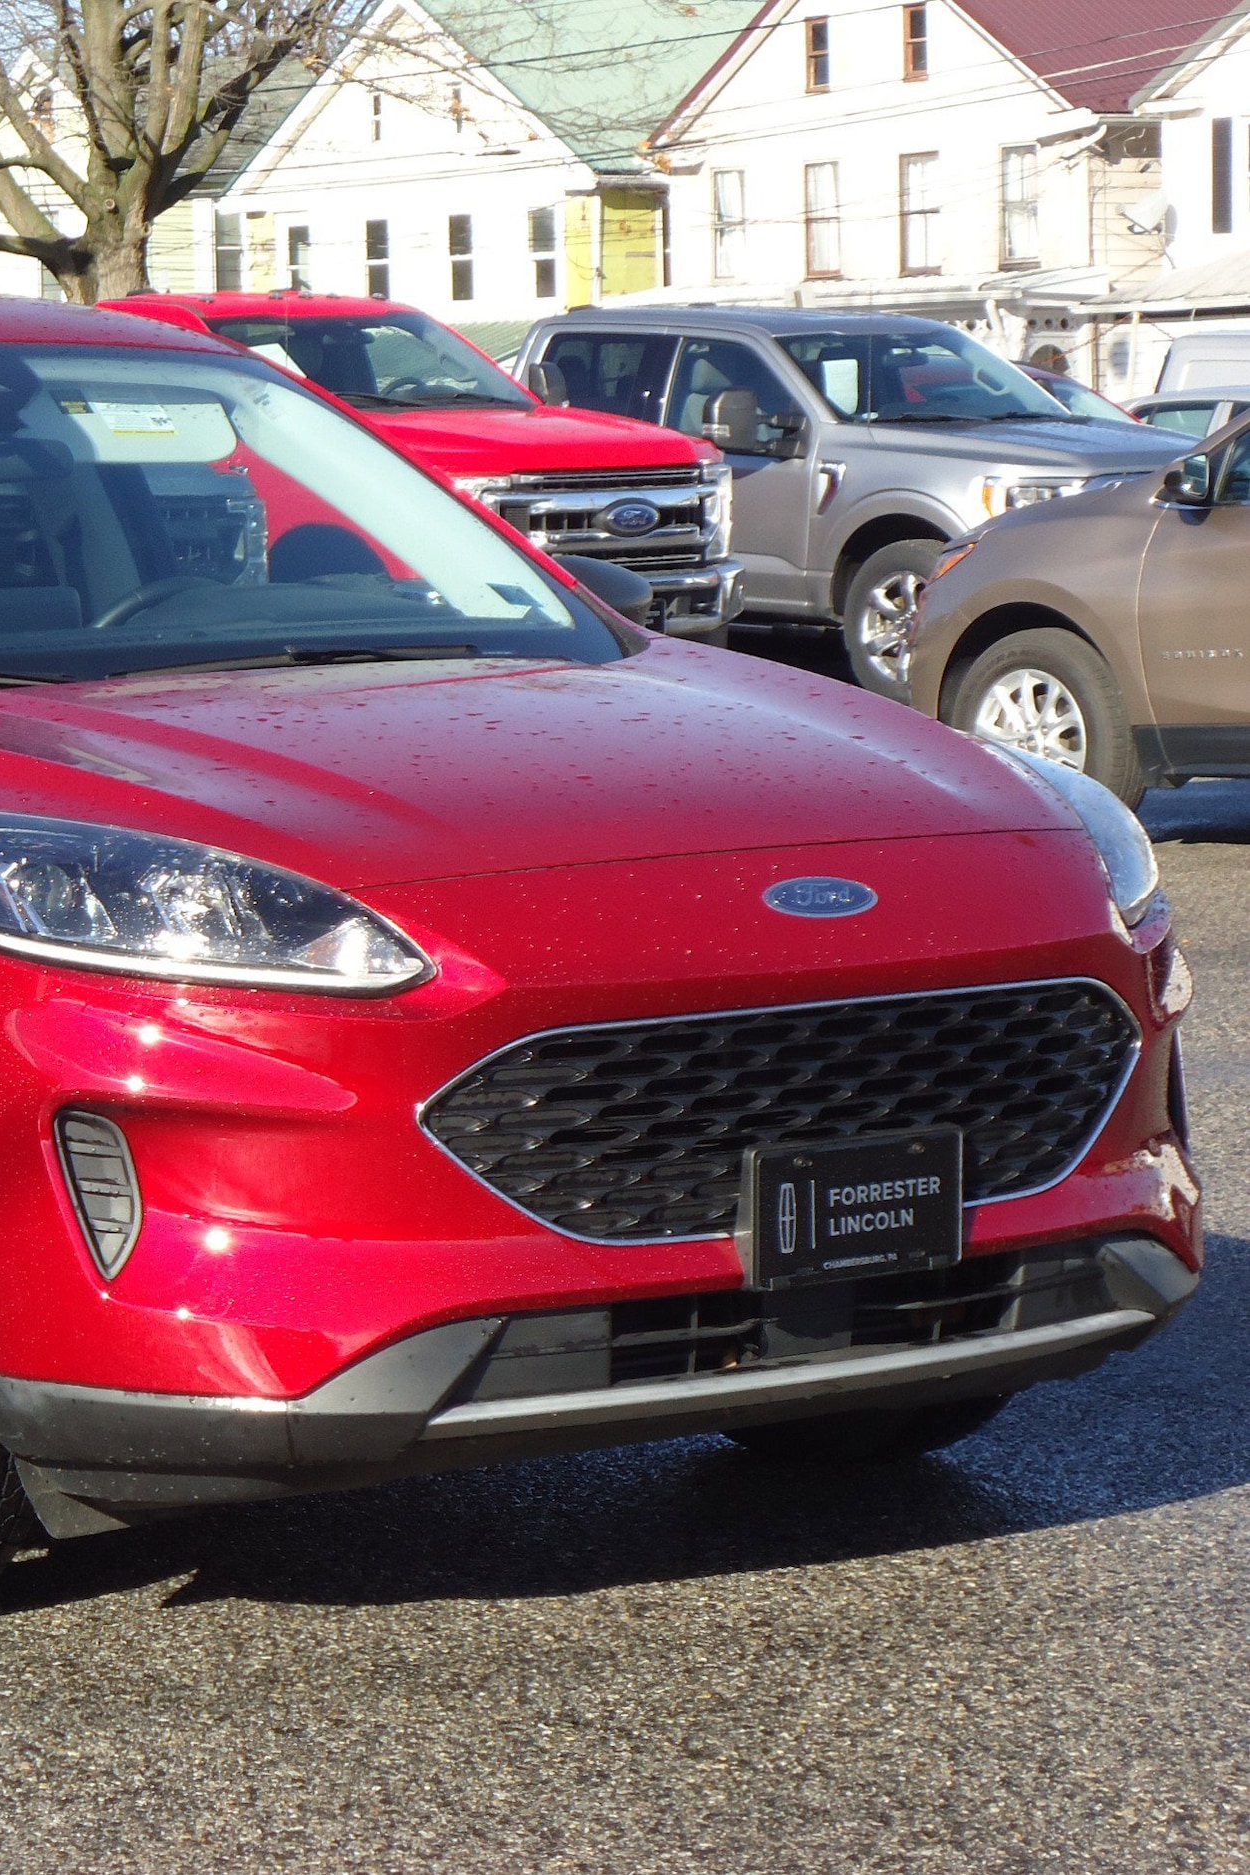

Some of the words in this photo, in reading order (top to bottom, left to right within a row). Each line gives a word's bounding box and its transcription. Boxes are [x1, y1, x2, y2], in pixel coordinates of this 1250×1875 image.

[793, 881, 855, 907] Ford
[829, 1176, 941, 1207] FORRESTER
[829, 1208, 915, 1237] LINCOLN
